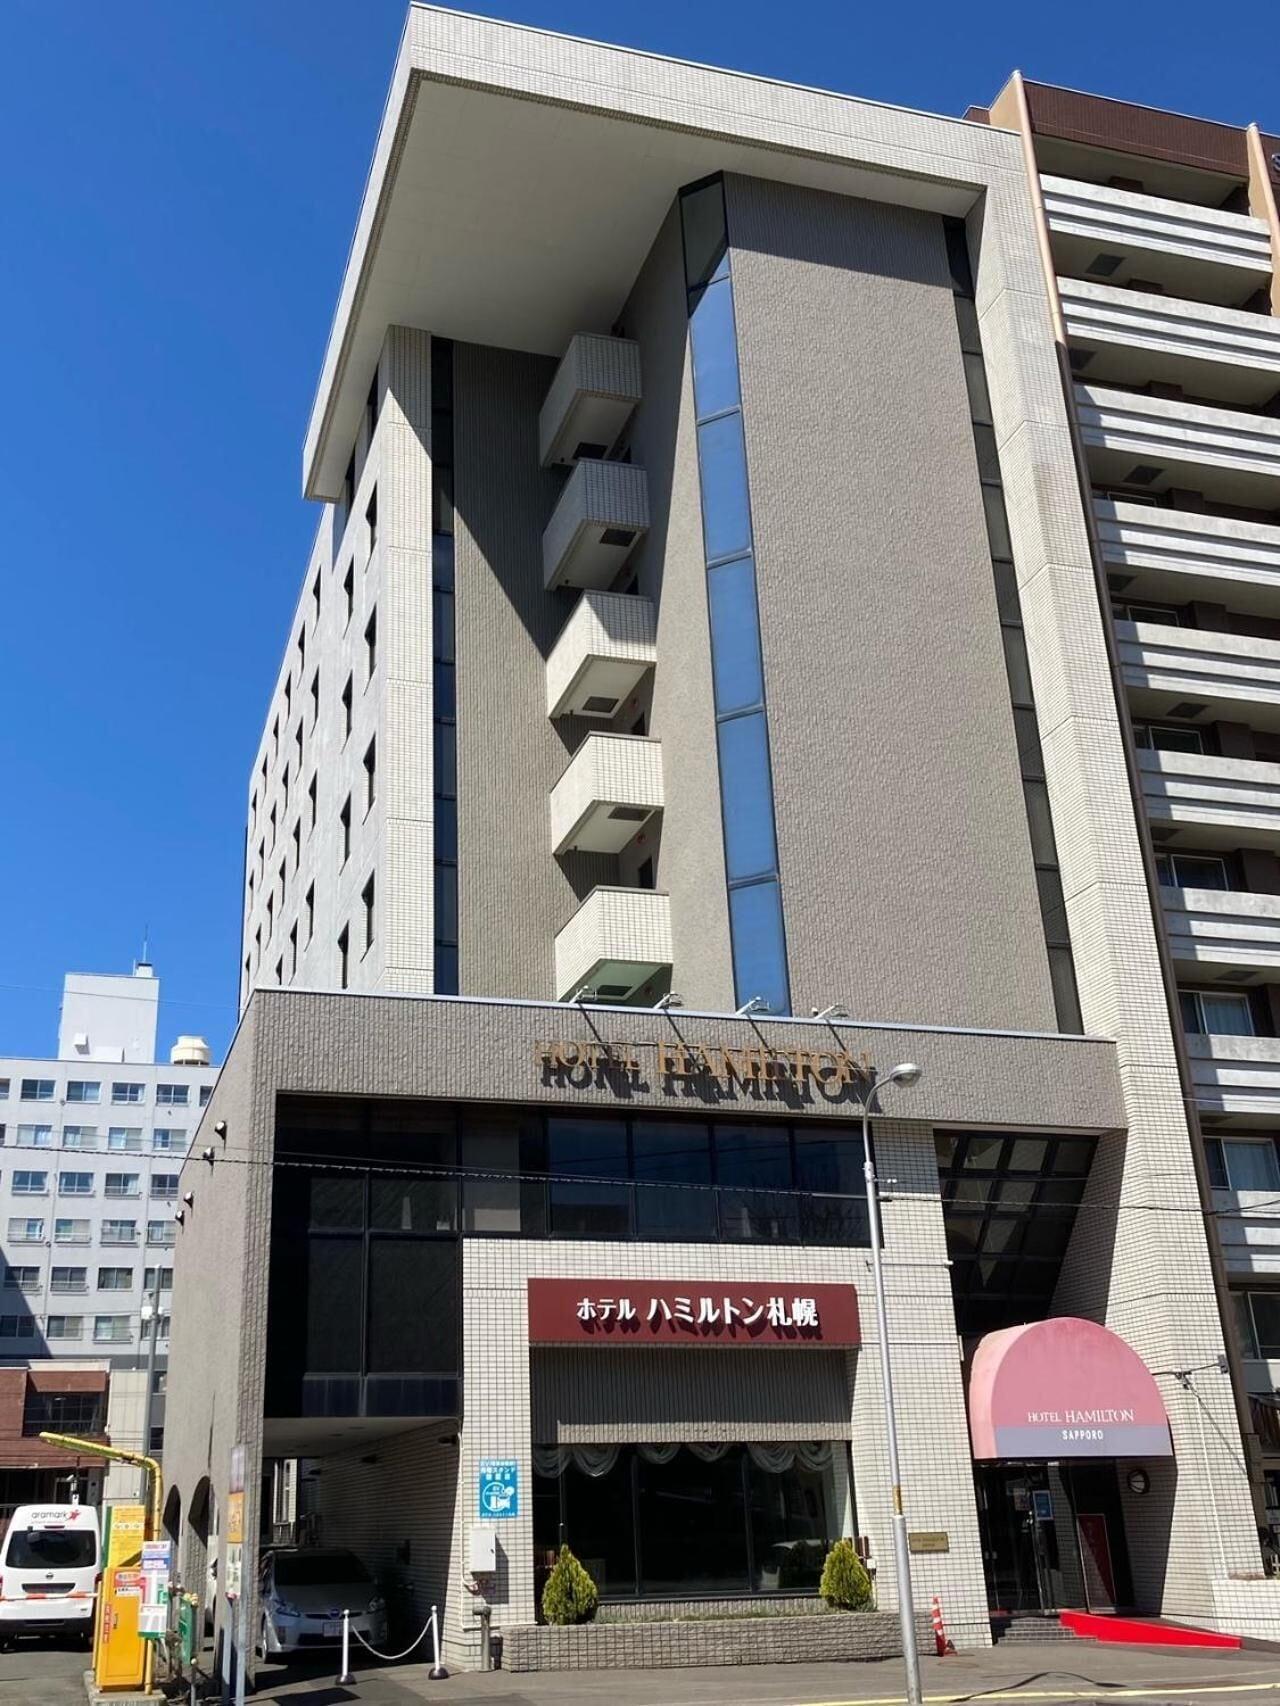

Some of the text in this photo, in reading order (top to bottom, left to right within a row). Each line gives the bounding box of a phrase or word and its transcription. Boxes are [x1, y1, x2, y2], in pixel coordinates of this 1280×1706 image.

[534, 1039, 872, 1084] HOTEL HAMILTON
[576, 1297, 818, 1327] ホテル ハミルトン札幌
[1027, 1409, 1134, 1423] HOTEL HAMILTON
[1062, 1430, 1104, 1440] SAPPORO
[31, 1511, 67, 1519] aramark
